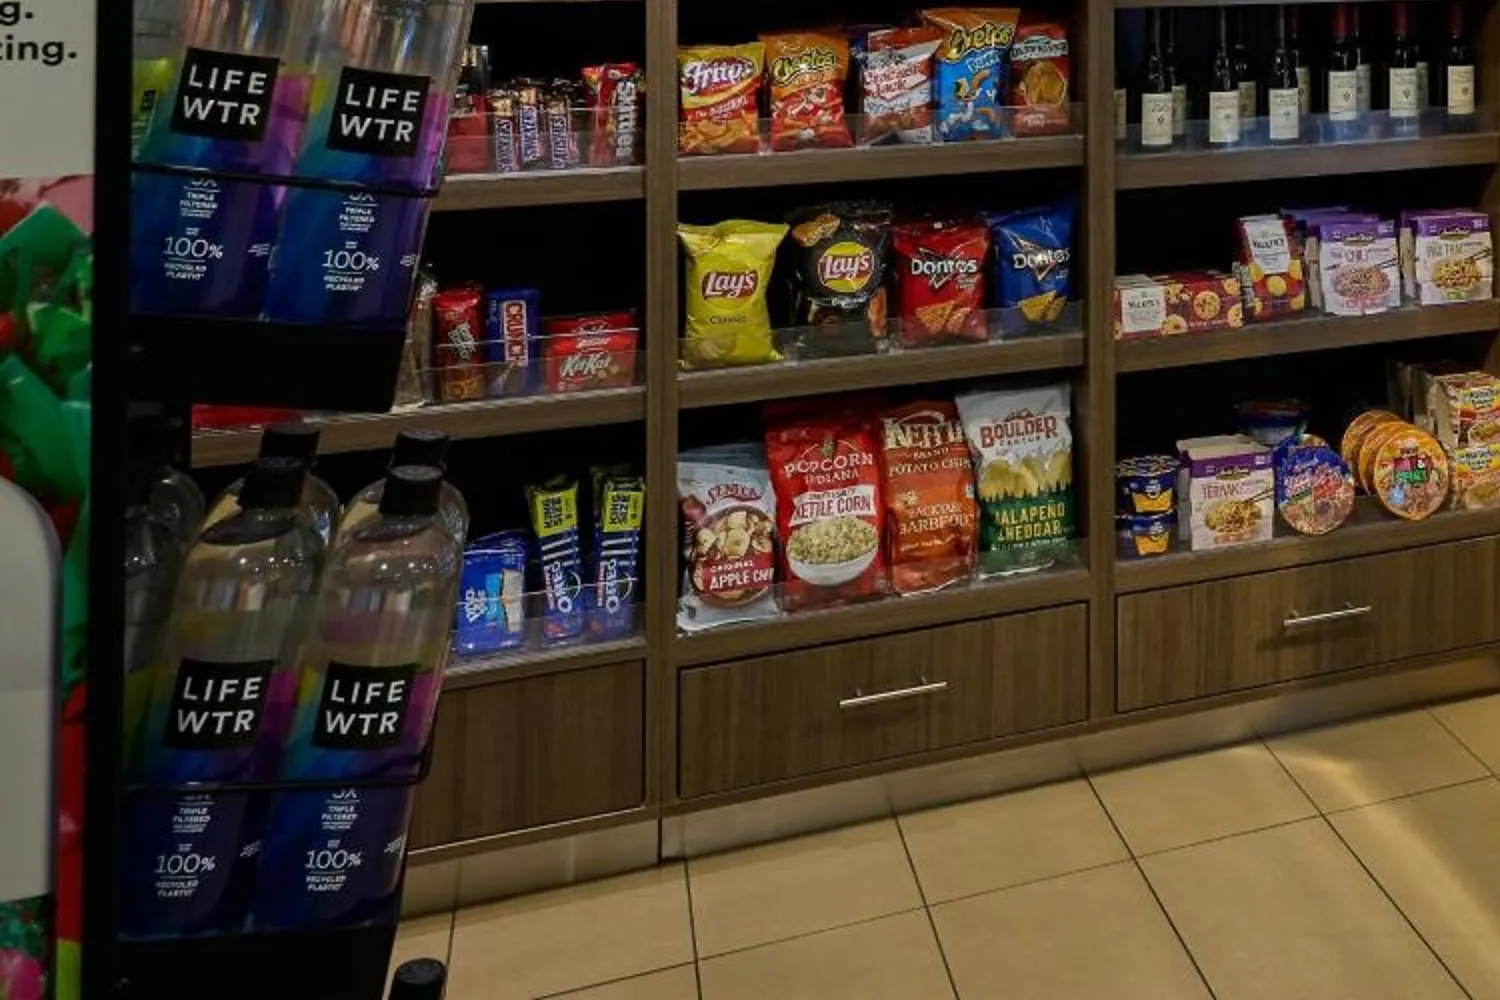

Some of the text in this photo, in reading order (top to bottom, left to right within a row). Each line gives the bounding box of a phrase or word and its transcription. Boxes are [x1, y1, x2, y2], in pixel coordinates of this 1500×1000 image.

[188, 63, 268, 96] LIFE
[345, 83, 421, 114] LIFE
[182, 97, 262, 128] WTR
[339, 113, 415, 144] WTR
[162, 236, 224, 260] 100%
[321, 249, 379, 272] 100%
[1013, 247, 1071, 270] Doritos
[823, 252, 873, 283] Lay's
[911, 257, 978, 276] Doritos
[703, 269, 757, 300] Lay's
[979, 415, 1058, 449] BOULDER
[784, 453, 874, 479] POPCORN
[837, 496, 871, 513] CORN
[551, 561, 573, 614] OREO
[604, 558, 619, 614] OREO
[709, 570, 751, 591] APPLE
[182, 676, 263, 702] LIFE
[330, 679, 406, 703] LIFE
[175, 709, 255, 735] WTR
[323, 711, 400, 736] WTR
[154, 853, 216, 874] 100%
[305, 849, 362, 869] 100%
